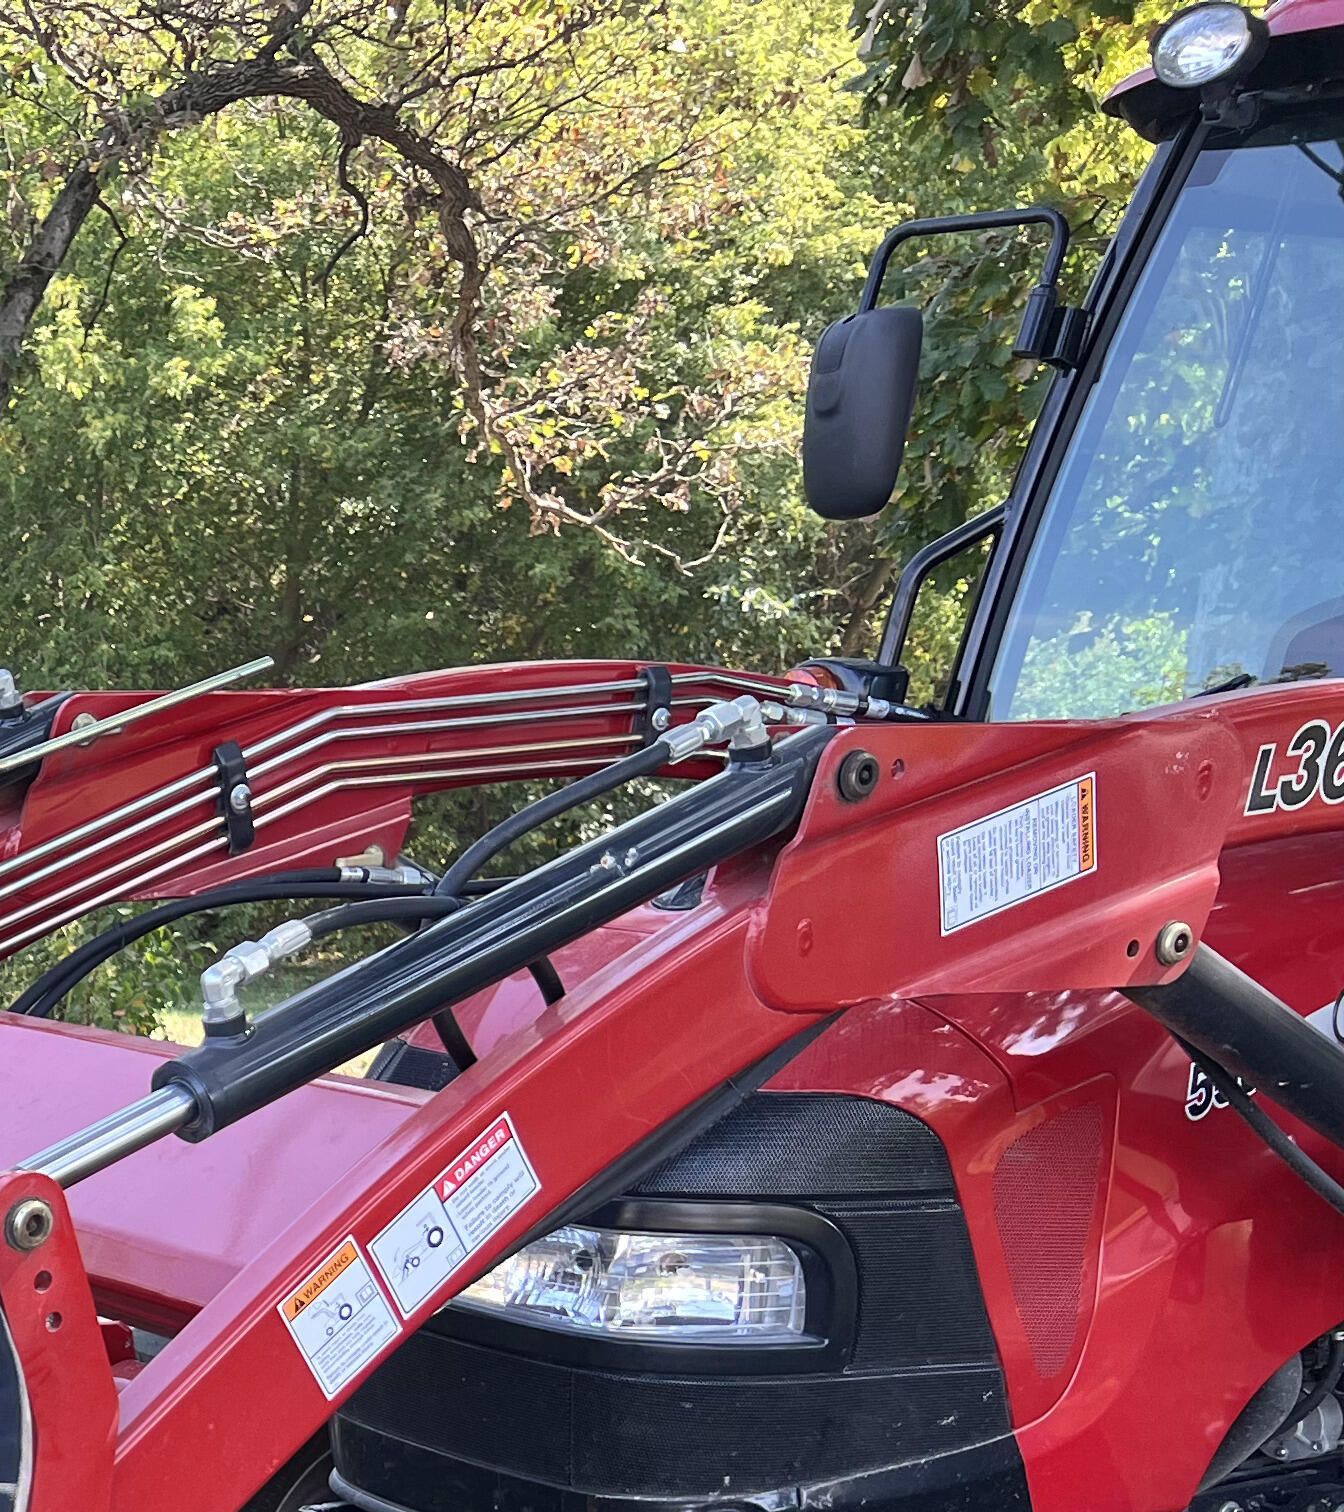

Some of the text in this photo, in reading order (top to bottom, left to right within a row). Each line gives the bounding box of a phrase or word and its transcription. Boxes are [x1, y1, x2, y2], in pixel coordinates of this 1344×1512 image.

[1082, 803, 1090, 863] WARNING
[454, 1128, 506, 1181] DANGER
[303, 1252, 349, 1299] WARNING
